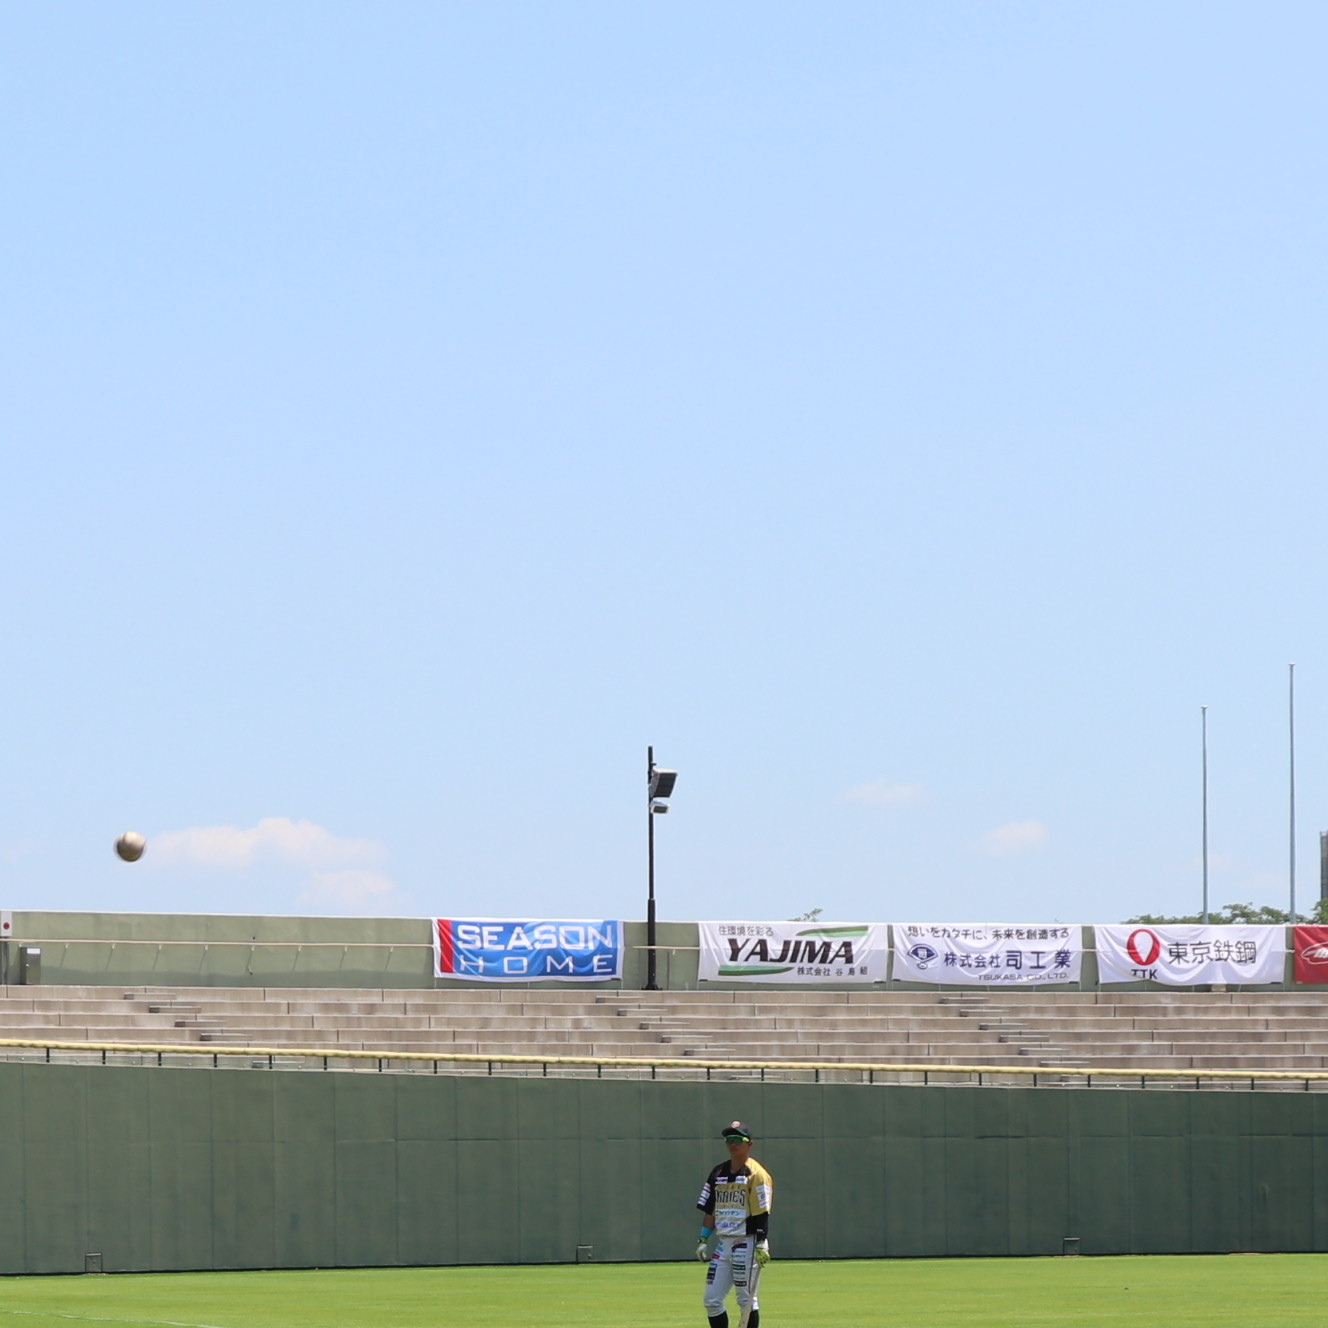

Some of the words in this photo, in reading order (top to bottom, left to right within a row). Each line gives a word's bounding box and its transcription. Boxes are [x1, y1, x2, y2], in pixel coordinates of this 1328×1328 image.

[457, 924, 613, 950] SEASON
[718, 925, 774, 937] 住環境を彩る
[727, 938, 854, 964] YAJIMA
[1167, 939, 1257, 964] 東京鉄鋼
[460, 954, 613, 974] HOME
[978, 973, 1023, 981] TSUKASA
